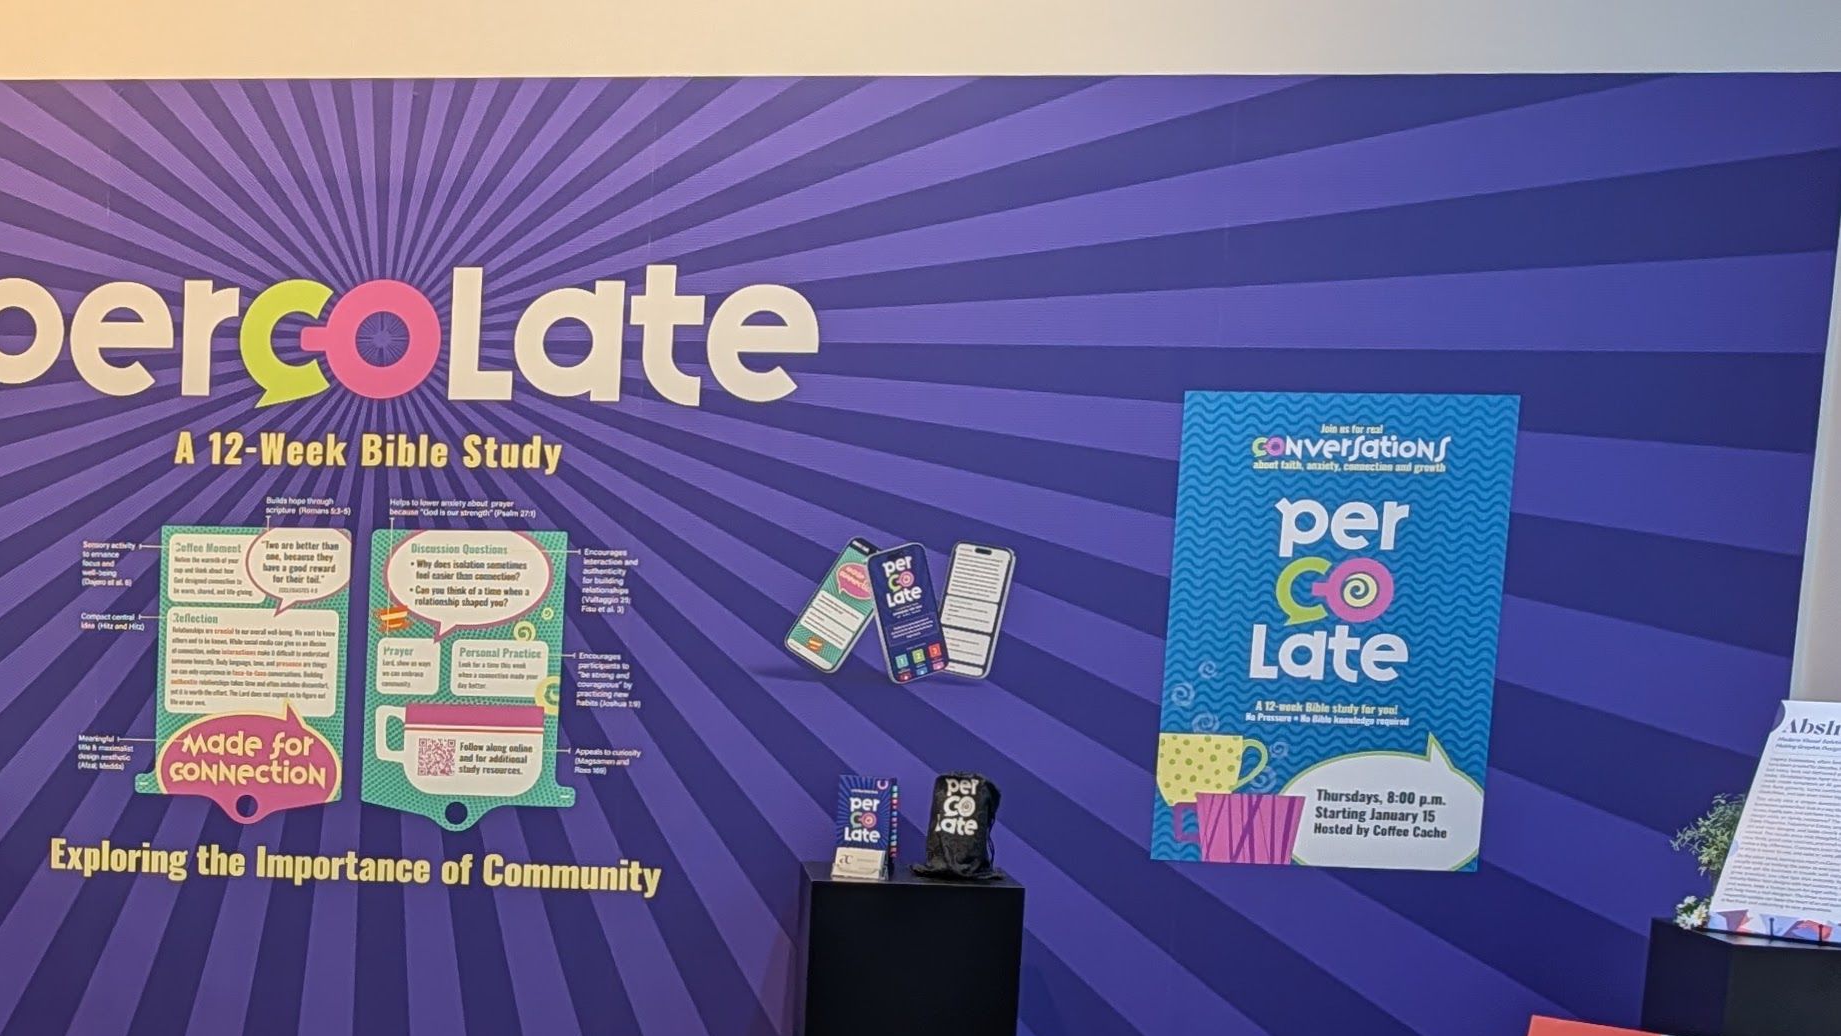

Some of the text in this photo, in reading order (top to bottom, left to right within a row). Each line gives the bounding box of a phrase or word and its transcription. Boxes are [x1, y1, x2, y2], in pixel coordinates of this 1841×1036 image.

[1321, 424, 1383, 434] Join us for real
[174, 431, 563, 475] A 12-Week Bible Study
[1275, 497, 1410, 557] per
[206, 542, 242, 554] Moment
[281, 542, 294, 551] are
[296, 541, 319, 551] better
[321, 542, 339, 551] than
[410, 543, 508, 556] Discussion Questions
[265, 552, 334, 564] one, because they
[263, 563, 336, 574] have a good reward
[417, 559, 527, 571] Why does isolation sometimes
[882, 555, 913, 578] per
[273, 574, 285, 583] for
[287, 574, 305, 584] their
[416, 571, 520, 582] feel easier than connection?
[415, 586, 430, 595] Can
[432, 587, 445, 596] you
[447, 587, 467, 596] think
[468, 587, 476, 596] of
[484, 587, 502, 596] time
[503, 587, 523, 596] when
[415, 597, 509, 609] relationship shaped you?
[459, 647, 542, 660] Personal Practice
[1249, 624, 1408, 683] Late
[1255, 701, 1398, 716] A 12-week Bible study for you!
[182, 730, 314, 760] Made for
[460, 741, 533, 754] Follow along online
[459, 753, 528, 764] and for additional
[459, 765, 523, 776] study resources.
[945, 778, 980, 796] per
[1317, 788, 1446, 807] Thursdays, 8:00 p.m.
[849, 796, 880, 813] per
[1315, 806, 1436, 824] Starting January 15
[1314, 822, 1447, 838] Hosted by Coffee Cache
[50, 838, 662, 898] Exploring the Importance of Community
